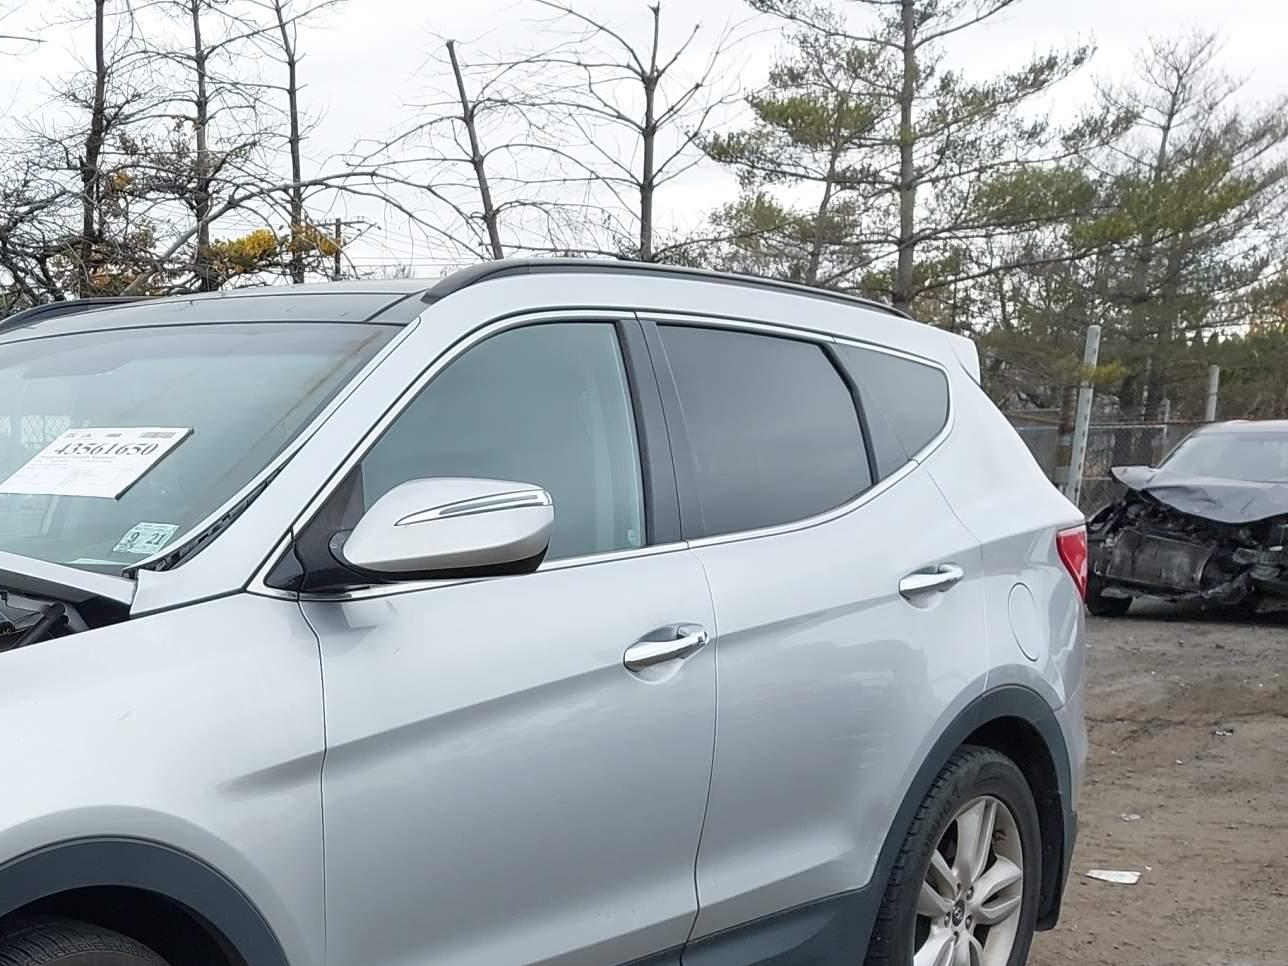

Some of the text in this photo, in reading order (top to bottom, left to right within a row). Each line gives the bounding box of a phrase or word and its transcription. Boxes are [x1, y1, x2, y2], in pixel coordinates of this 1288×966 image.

[54, 442, 159, 456] 43561650
[127, 531, 166, 545] 9 21
